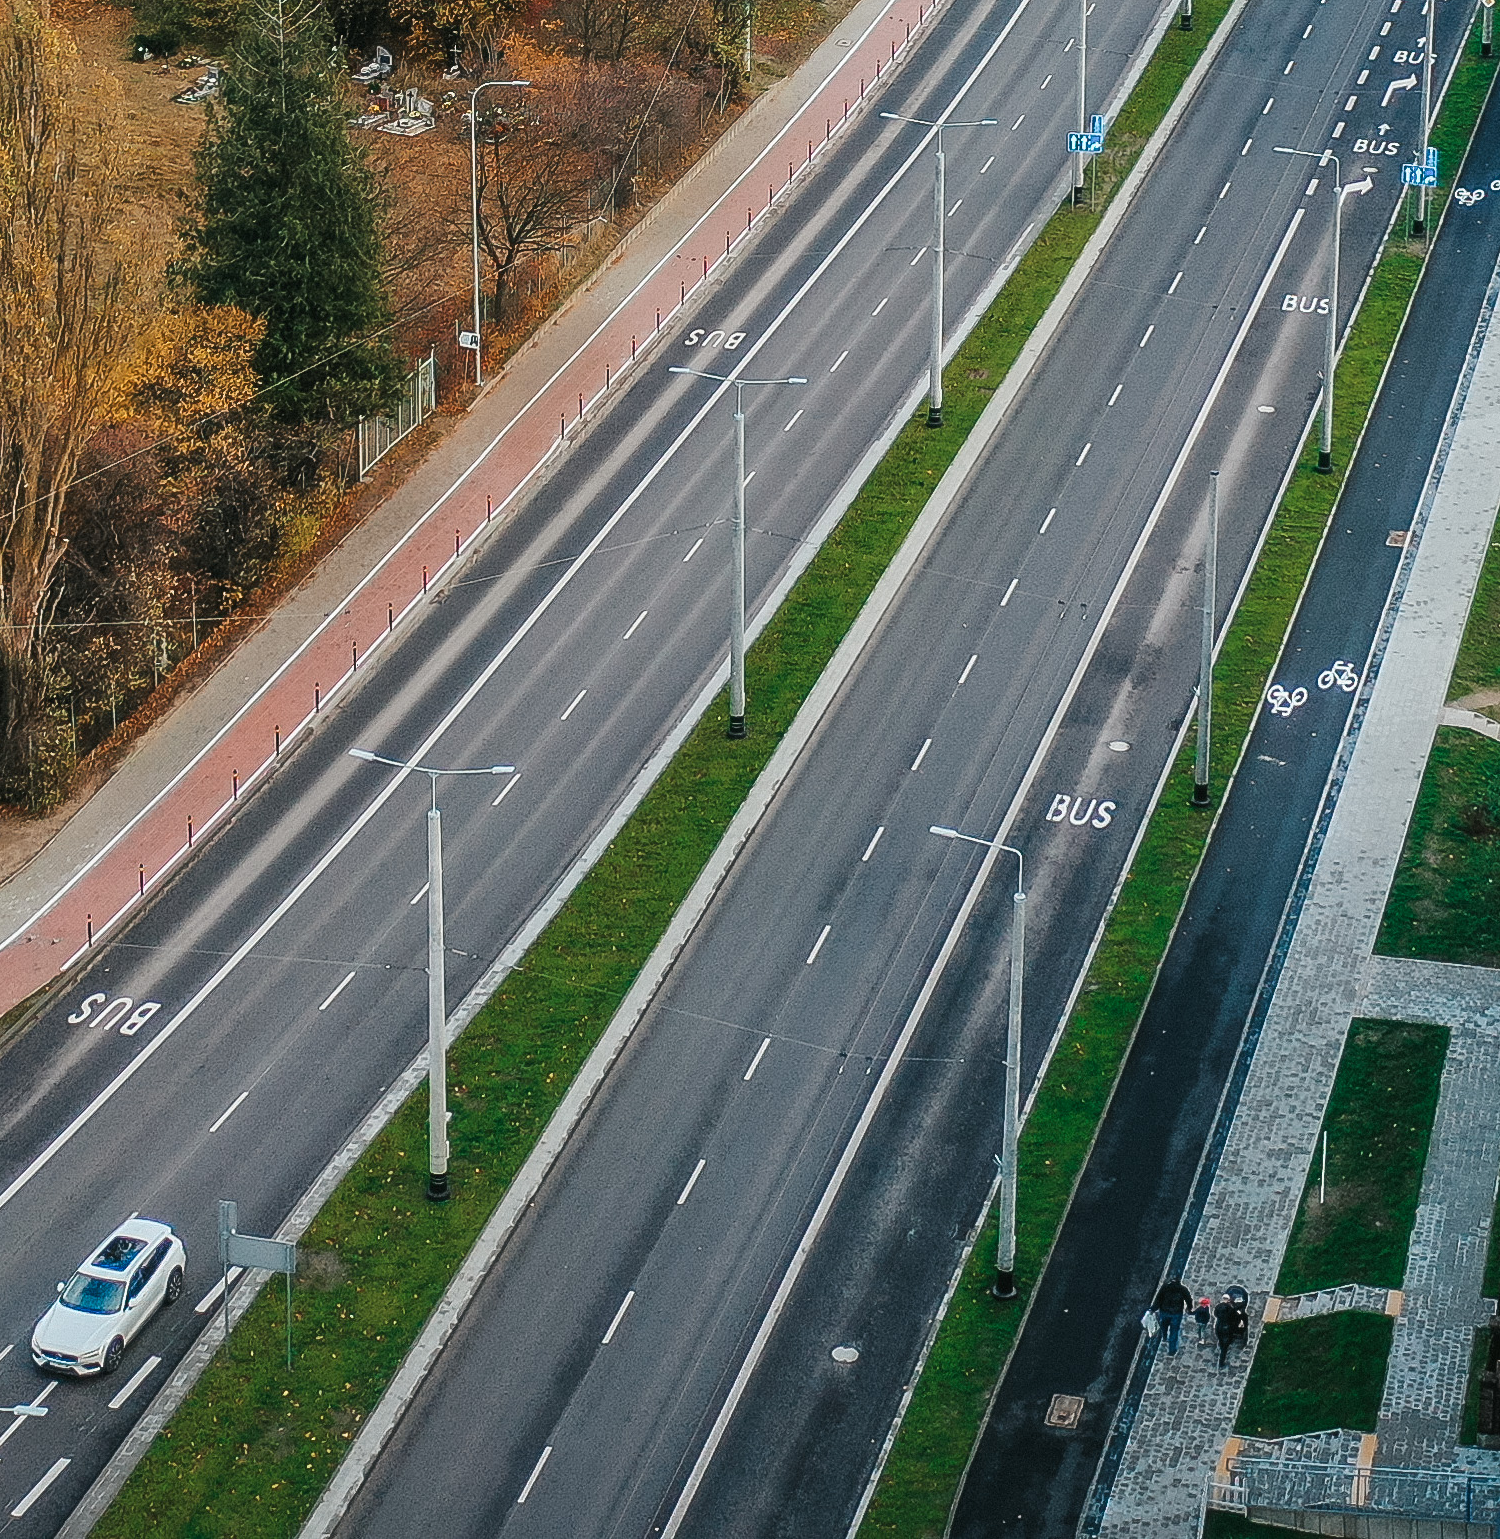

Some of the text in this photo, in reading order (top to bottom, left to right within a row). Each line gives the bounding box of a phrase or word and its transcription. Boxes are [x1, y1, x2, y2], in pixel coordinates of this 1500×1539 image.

[1393, 50, 1438, 65] BUS
[1353, 138, 1400, 155] BUS
[1281, 294, 1330, 314] BUS
[684, 328, 747, 350] BUS
[1045, 793, 1117, 829] BUS
[67, 992, 162, 1036] BUS
